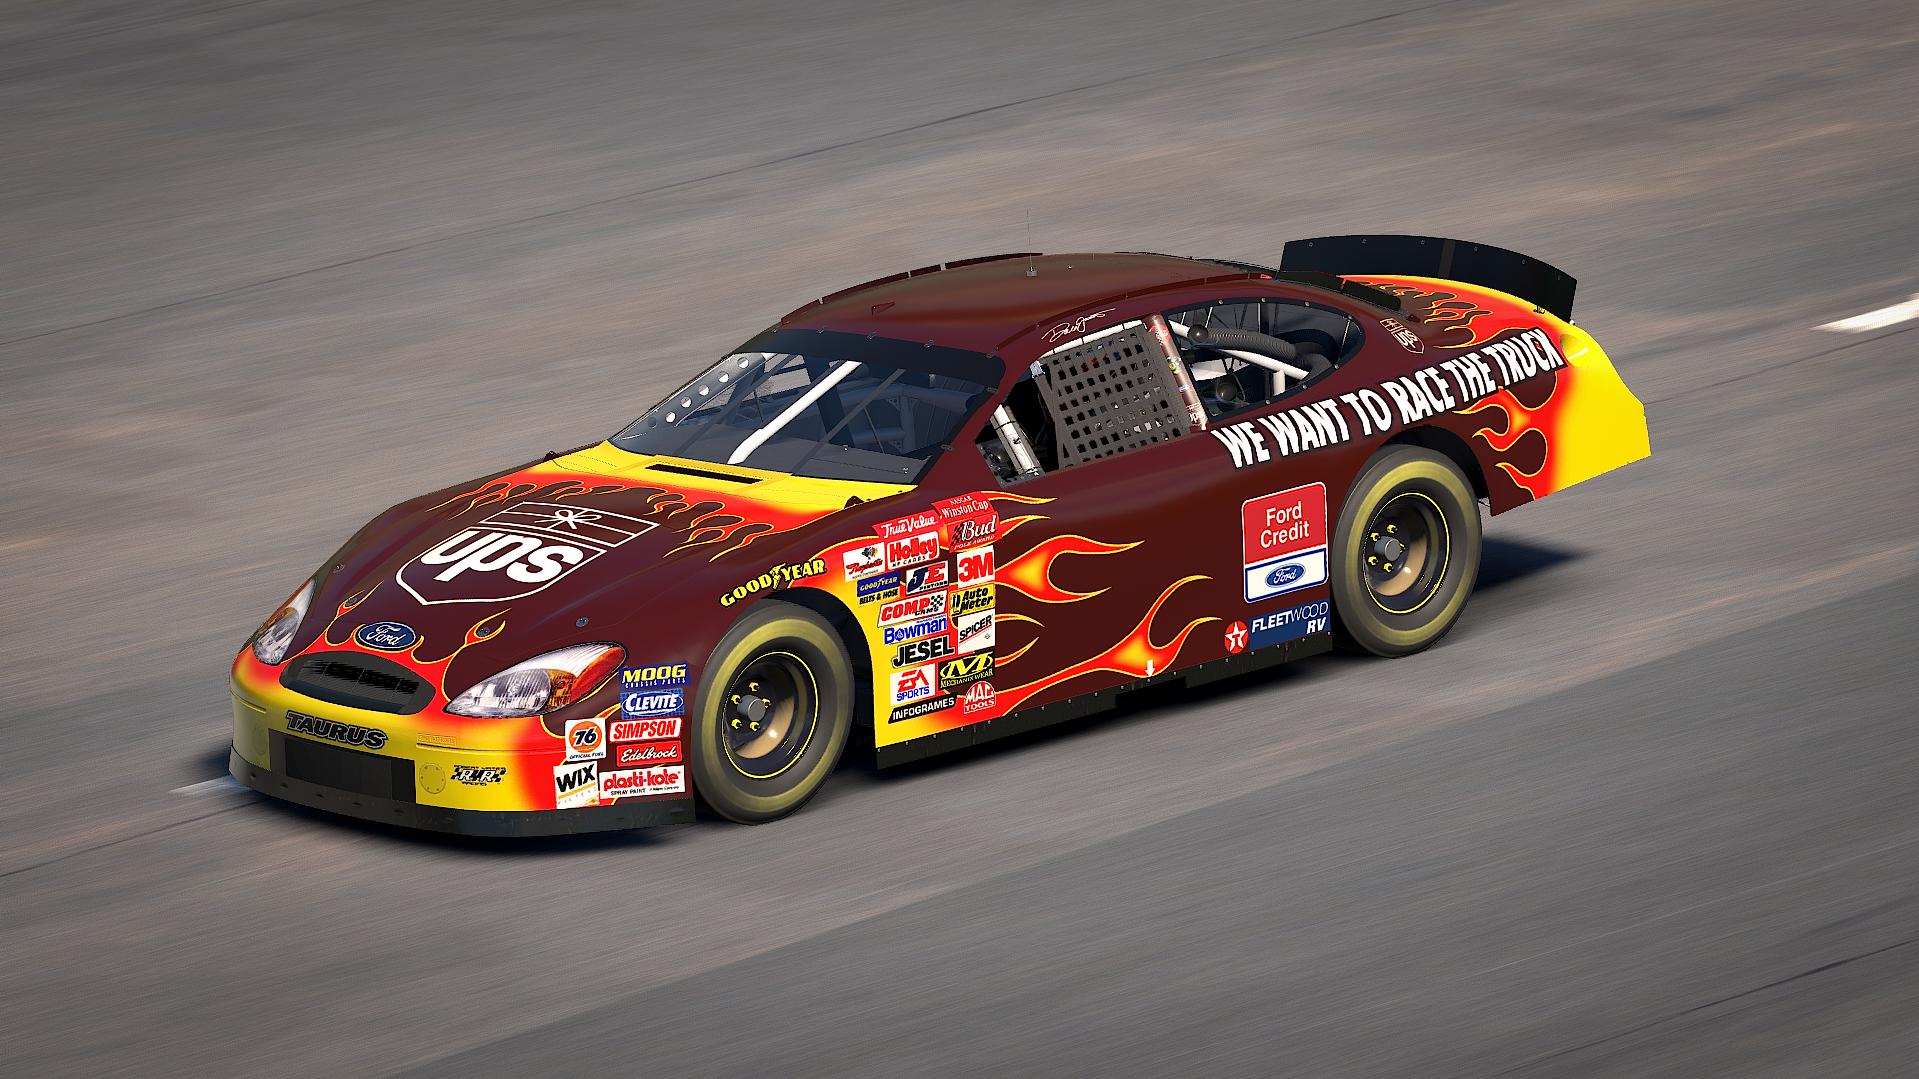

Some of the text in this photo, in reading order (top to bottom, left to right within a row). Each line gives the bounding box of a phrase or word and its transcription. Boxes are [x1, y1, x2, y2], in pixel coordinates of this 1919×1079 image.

[1211, 422, 1270, 469] WE
[1264, 399, 1350, 456] WANT
[1344, 386, 1393, 436] TO
[1386, 366, 1456, 425] RACE
[1448, 347, 1499, 403] THE
[1488, 328, 1564, 385] TRUCK
[941, 500, 989, 518] Winston Cup
[950, 496, 973, 505] NASCAR
[1266, 501, 1302, 527] Ford
[961, 515, 997, 541] Bud
[1260, 521, 1310, 549] Credit
[420, 530, 584, 584] ups
[889, 537, 938, 563] Holley
[958, 551, 994, 582] 3M
[1273, 567, 1297, 584] Ford
[859, 595, 876, 606] BELTS
[882, 588, 899, 599] HOSE
[960, 595, 994, 612] Meter
[962, 587, 989, 600] Auto
[881, 597, 930, 621] COMP
[914, 605, 939, 616] CAMS
[1251, 602, 1328, 634] FLEETWOOD
[366, 624, 407, 646] Ford
[884, 617, 947, 645] Bowman
[959, 614, 992, 640] SPICER
[1306, 617, 1327, 635] RV
[892, 636, 954, 667] JESEL
[622, 664, 687, 684] MOOG
[898, 669, 930, 693] EA
[940, 668, 994, 689] MECHANIX WEAR
[896, 685, 930, 702] SPORTS
[965, 683, 995, 704] MAC
[892, 697, 955, 721] INFOGRAMES
[964, 699, 995, 711] TOOLS
[286, 710, 389, 750] TAURUS
[574, 727, 598, 746] 76
[613, 720, 677, 740] SIMPSON
[621, 745, 678, 763] Edelbrock
[556, 763, 596, 793] WIX
[603, 769, 680, 791] plasti-kote
